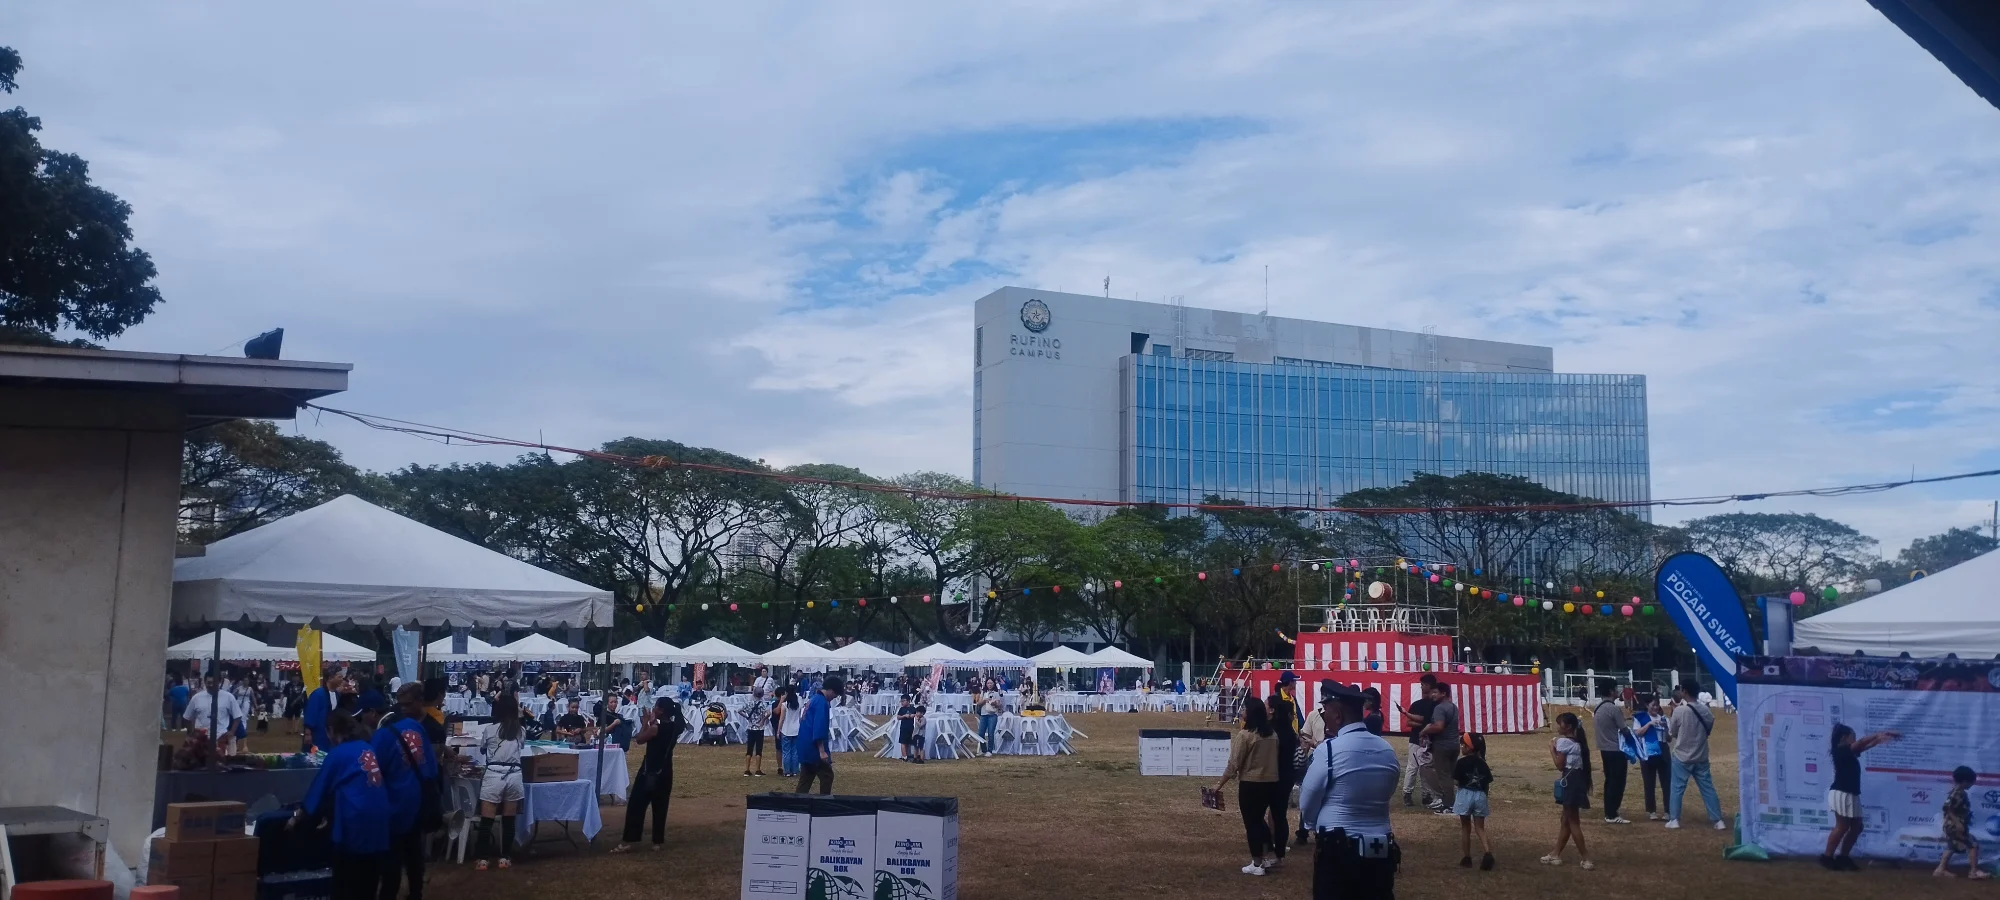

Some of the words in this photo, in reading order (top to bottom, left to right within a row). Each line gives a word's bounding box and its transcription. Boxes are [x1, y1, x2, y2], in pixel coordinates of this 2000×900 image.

[1010, 334, 1062, 349] RUFINO
[1010, 348, 1061, 360] CAMPUS
[1666, 572, 1711, 620] POCARI
[820, 856, 863, 866] BALIKBAYAN
[886, 858, 931, 868] BALIKBAYAN
